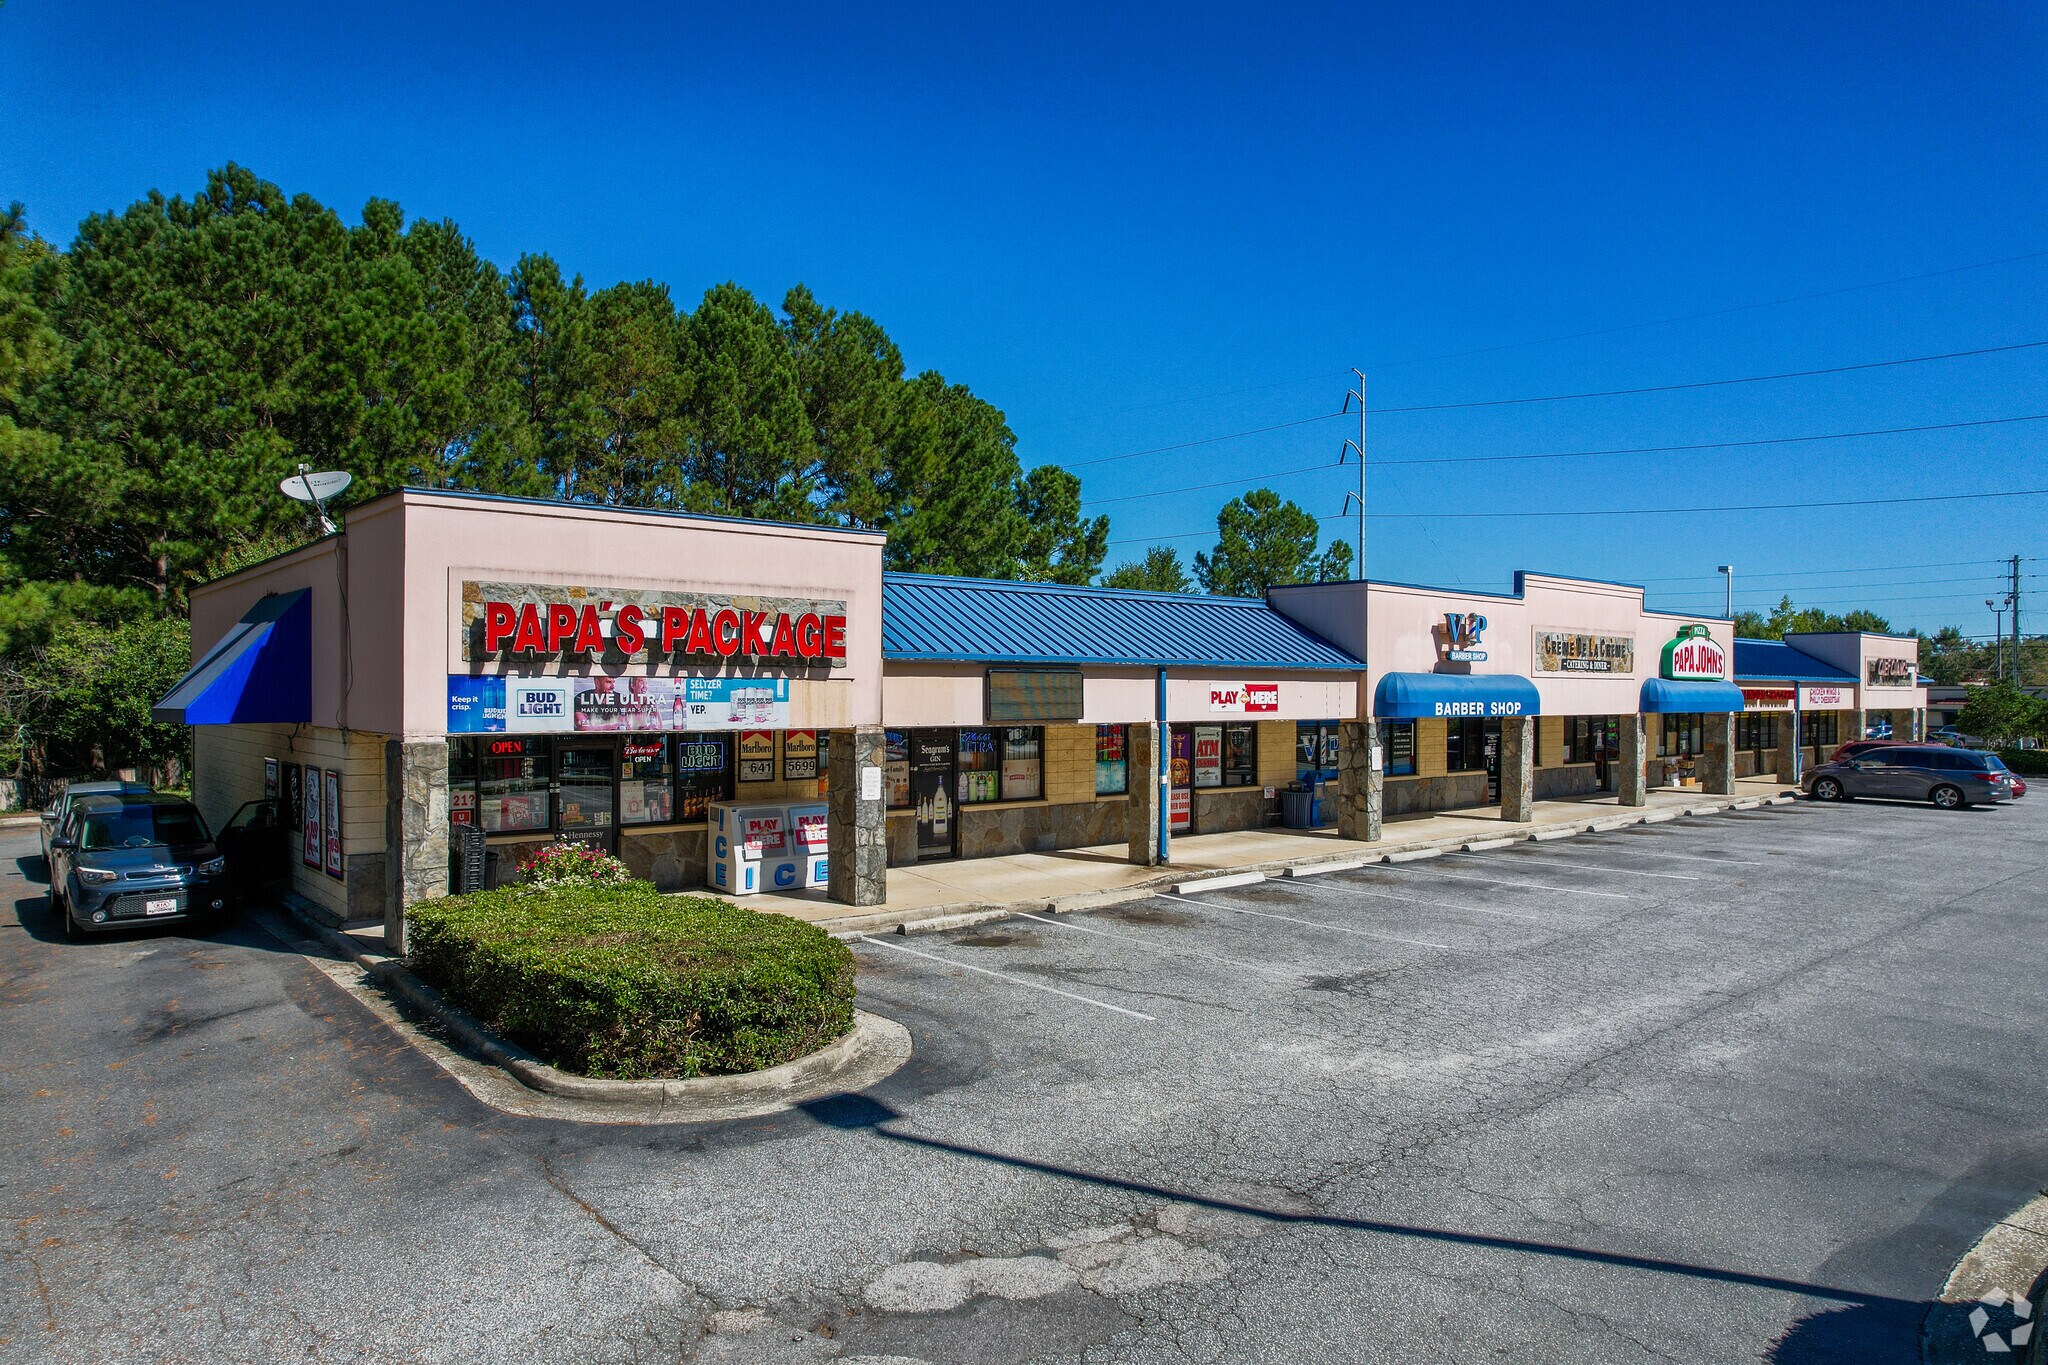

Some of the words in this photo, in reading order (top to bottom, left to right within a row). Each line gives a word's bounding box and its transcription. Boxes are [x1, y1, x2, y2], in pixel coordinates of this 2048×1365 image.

[484, 601, 645, 655] PAPA'S
[661, 606, 848, 659] PACKAGE
[1451, 651, 1472, 660] BARBER
[1472, 652, 1486, 660] SHOP
[1674, 645, 1695, 672] PAPA
[1696, 645, 1723, 673] JOHN'S
[690, 679, 722, 689] SELTZER
[451, 695, 472, 704] Keep
[472, 695, 479, 703] it
[525, 692, 557, 703] BUD
[580, 693, 615, 705] LIVE
[619, 693, 667, 705] ULTRA
[690, 690, 713, 700] TIME?
[1210, 690, 1239, 705] PLAY
[1250, 690, 1278, 705] HERE
[451, 703, 472, 711] crisp.
[519, 703, 563, 714] LIGHT
[690, 705, 707, 714] YEP.
[1435, 702, 1485, 716] BARBER
[1490, 701, 1522, 715] SHOP
[491, 741, 522, 754] OPEN
[687, 745, 716, 756] BUD
[741, 741, 772, 753] Marlboro
[786, 740, 816, 752] Marlboro
[921, 744, 950, 756] Seagram's
[1195, 739, 1219, 757] ATM
[681, 755, 722, 768] LIGHT
[1195, 757, 1219, 768] INSIDE
[453, 794, 476, 807] 21?
[749, 819, 778, 832] PLAY
[798, 815, 826, 827] PLAY
[568, 830, 604, 839] Hennessy
[751, 833, 782, 845] HERE
[800, 829, 828, 841] HERE
[715, 808, 727, 886] ICE
